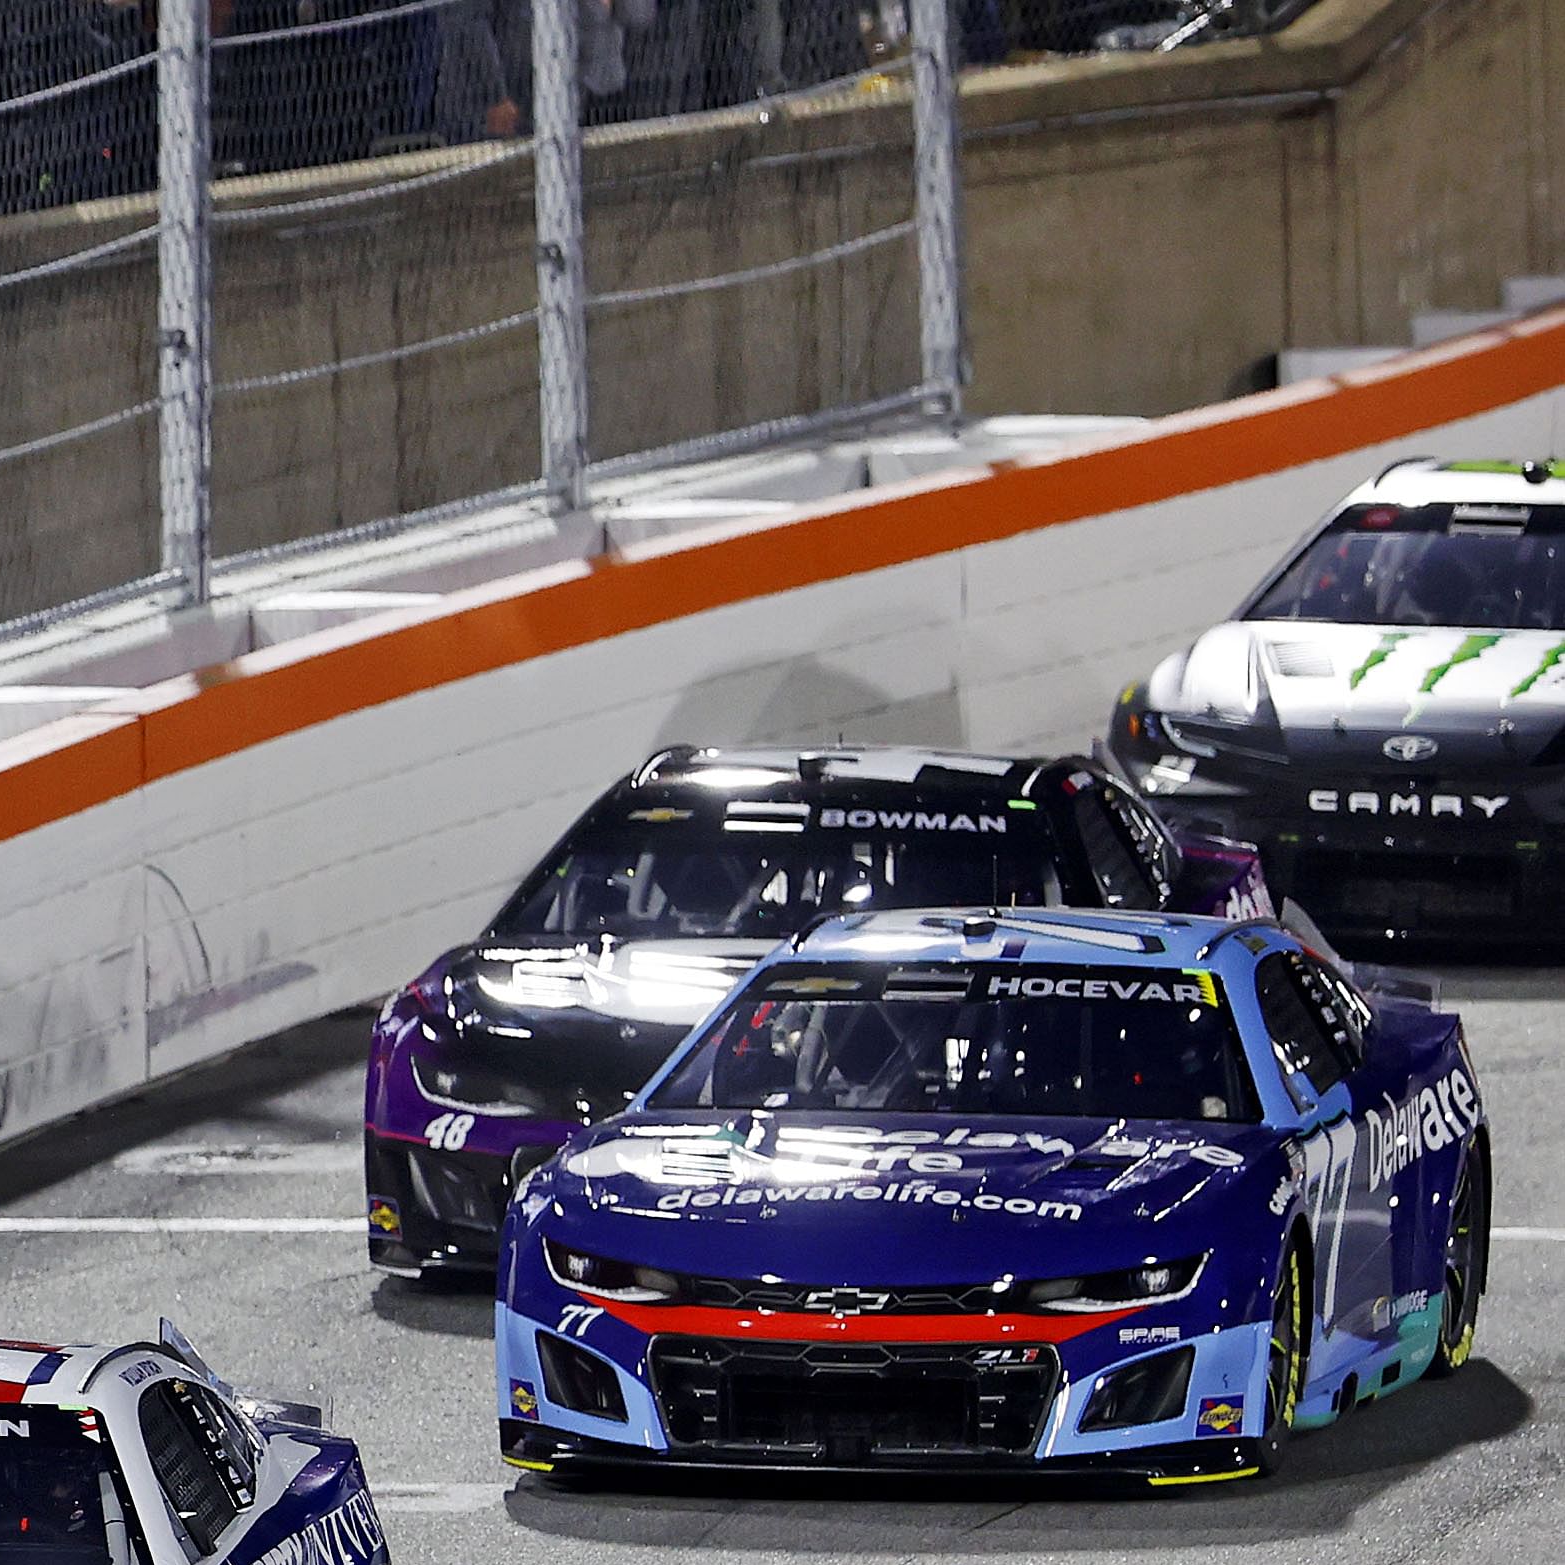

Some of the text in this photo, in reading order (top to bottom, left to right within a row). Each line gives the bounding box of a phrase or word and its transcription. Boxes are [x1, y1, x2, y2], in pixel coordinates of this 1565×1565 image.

[1309, 789, 1509, 819] CAMRY
[820, 808, 1007, 833] BOWMAN
[987, 974, 1202, 1002] HOCEVAR
[424, 1112, 475, 1151] 48
[1365, 1068, 1478, 1192] Delaware
[657, 1182, 1083, 1222] delawarelife.com
[557, 1304, 605, 1337] 77
[973, 1348, 1040, 1364] ZL1
